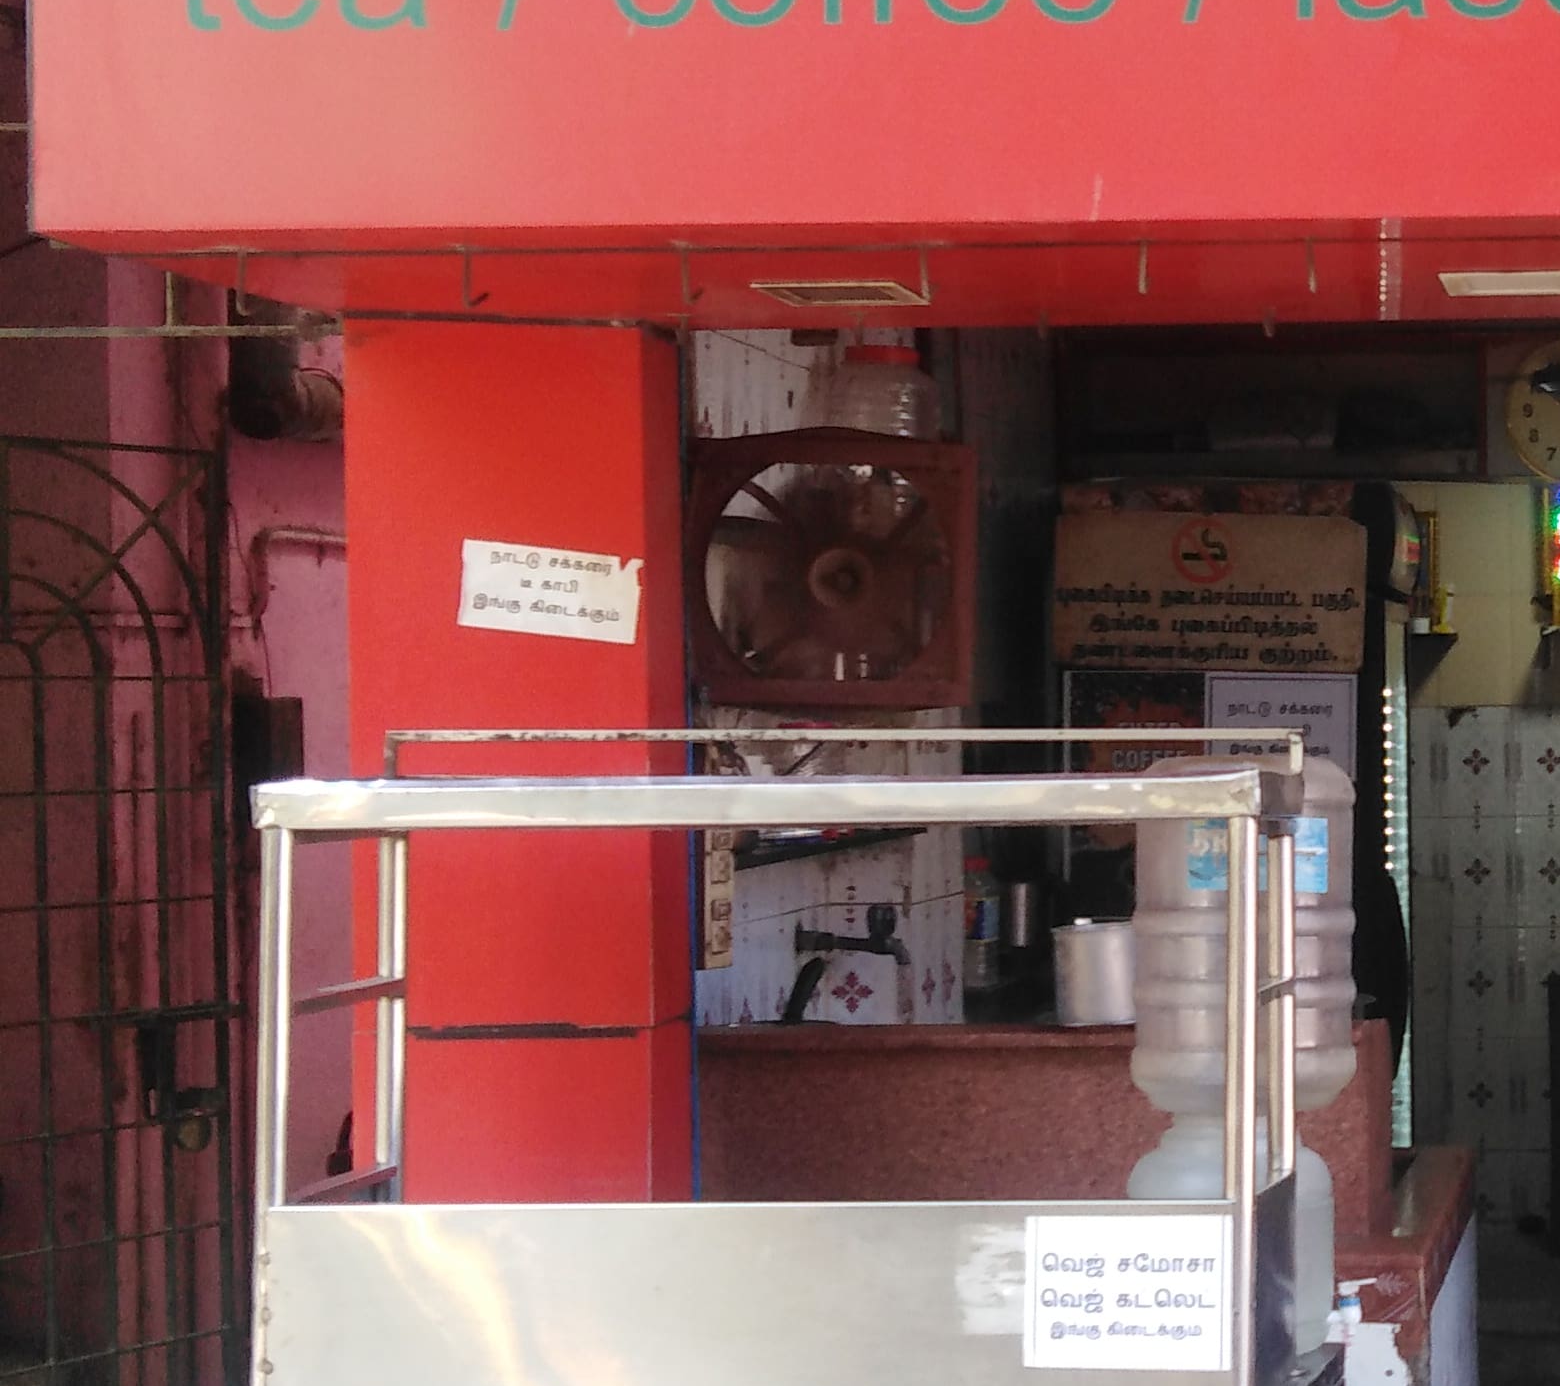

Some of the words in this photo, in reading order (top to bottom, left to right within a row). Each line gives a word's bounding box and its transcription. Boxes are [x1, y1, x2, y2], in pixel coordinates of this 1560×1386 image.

[1522, 403, 1533, 418] 9
[1546, 447, 1557, 461] 7
[1041, 1252, 1106, 1278] வெஜ்
[1117, 1253, 1216, 1273] சமோசா
[1040, 1288, 1104, 1314] வெஜ்
